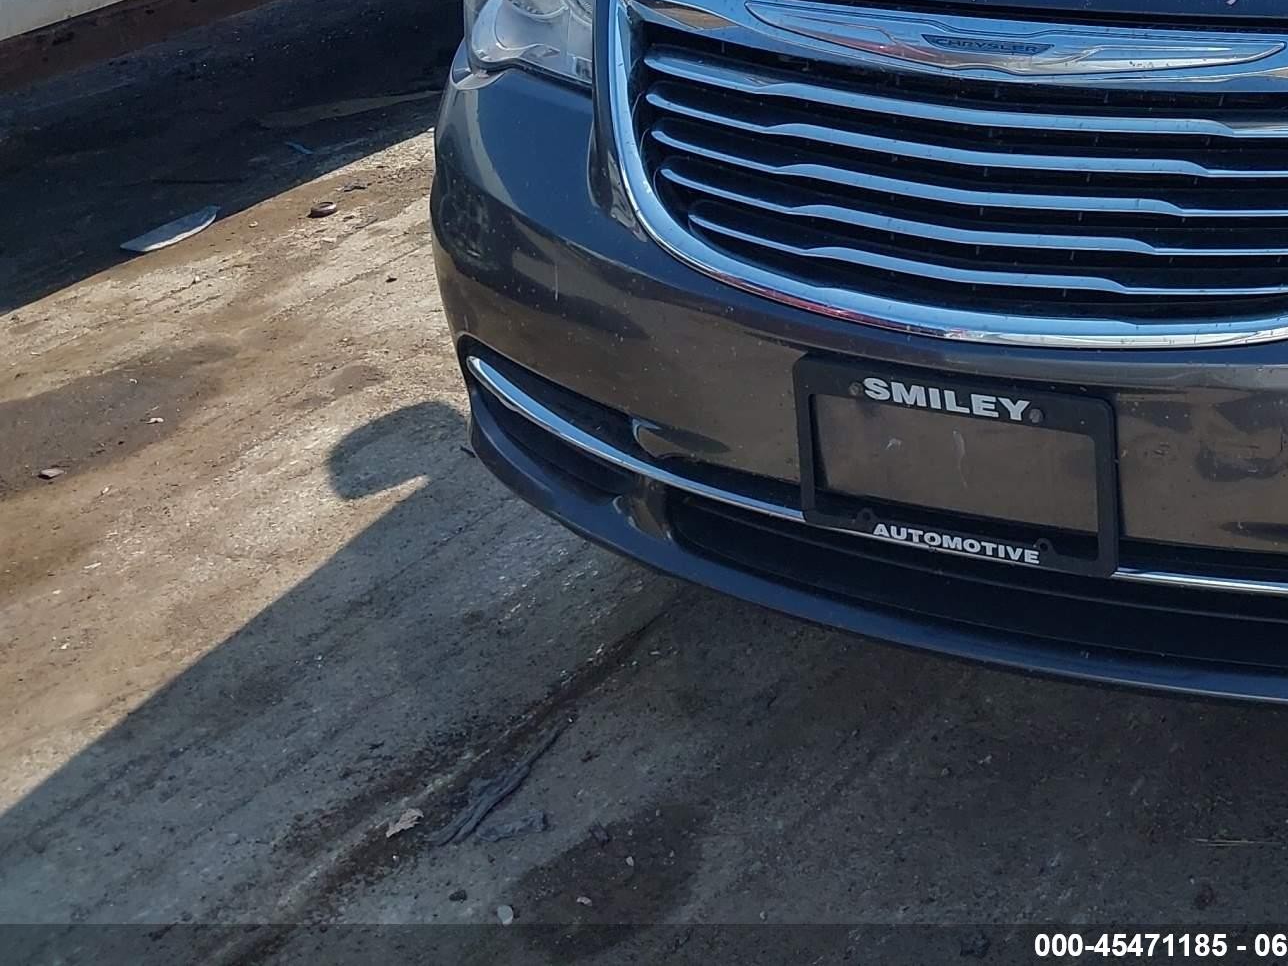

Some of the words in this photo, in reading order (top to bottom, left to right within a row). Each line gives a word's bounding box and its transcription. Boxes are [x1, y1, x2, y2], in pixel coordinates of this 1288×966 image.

[933, 37, 1038, 54] CHRYSLER
[862, 377, 1032, 422] SMILEY
[872, 522, 1041, 565] AUTOMOTIVE
